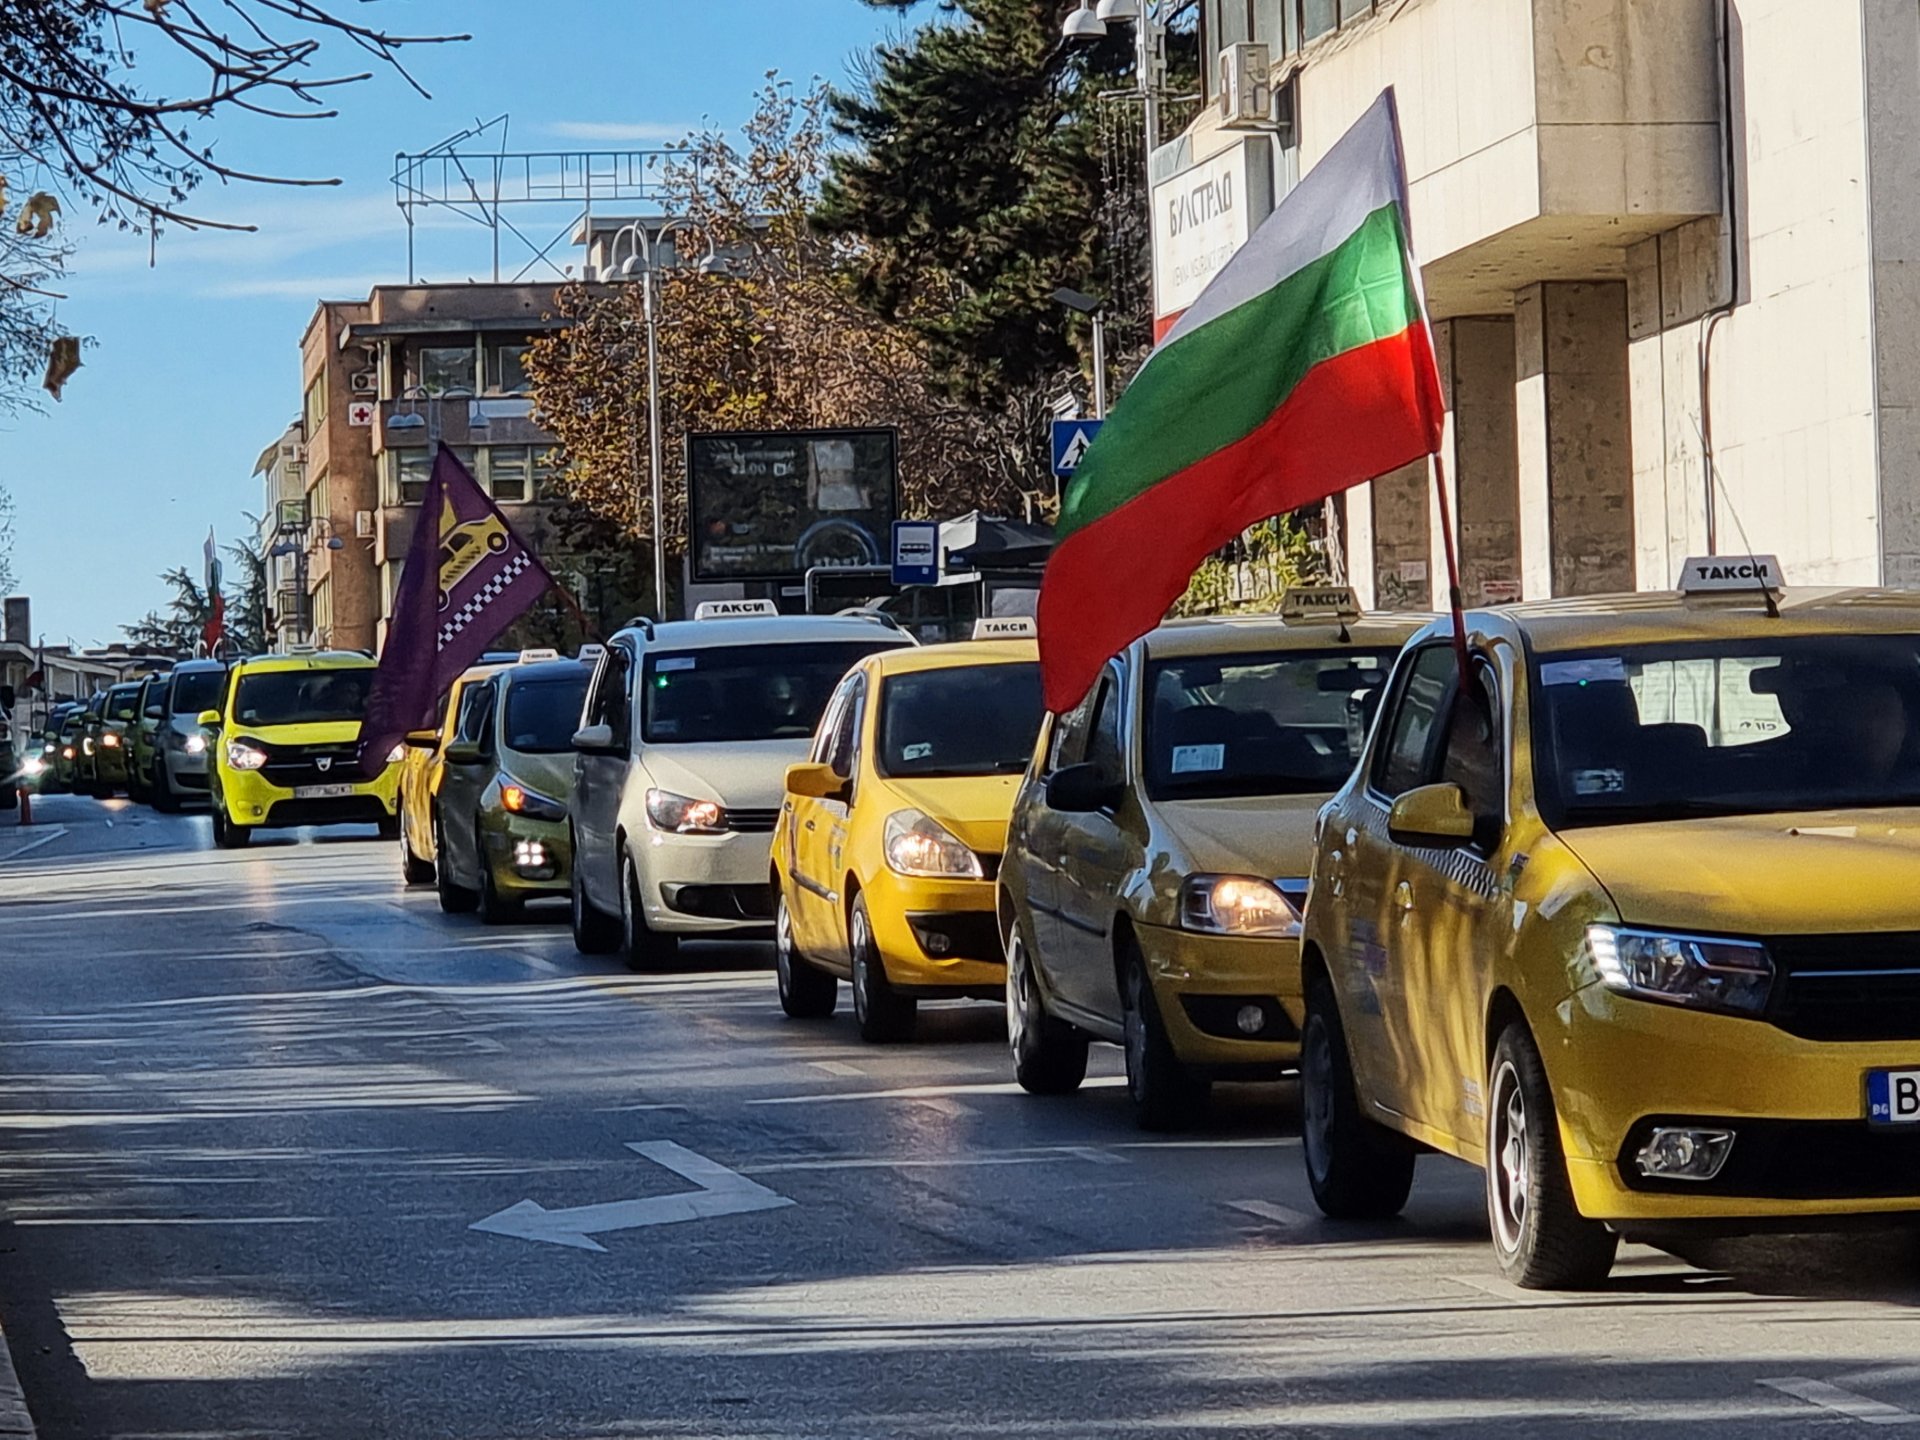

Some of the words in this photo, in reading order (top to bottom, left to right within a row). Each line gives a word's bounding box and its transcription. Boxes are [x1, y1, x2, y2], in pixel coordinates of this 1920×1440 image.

[1170, 171, 1233, 238] БУЛСТРАД
[1697, 564, 1768, 580] ТАКСИ
[1293, 592, 1350, 606] ТАКСИ
[712, 602, 765, 613] ТАКСИ
[985, 623, 1028, 632] ТАКСИ
[1872, 1103, 1889, 1115] BG
